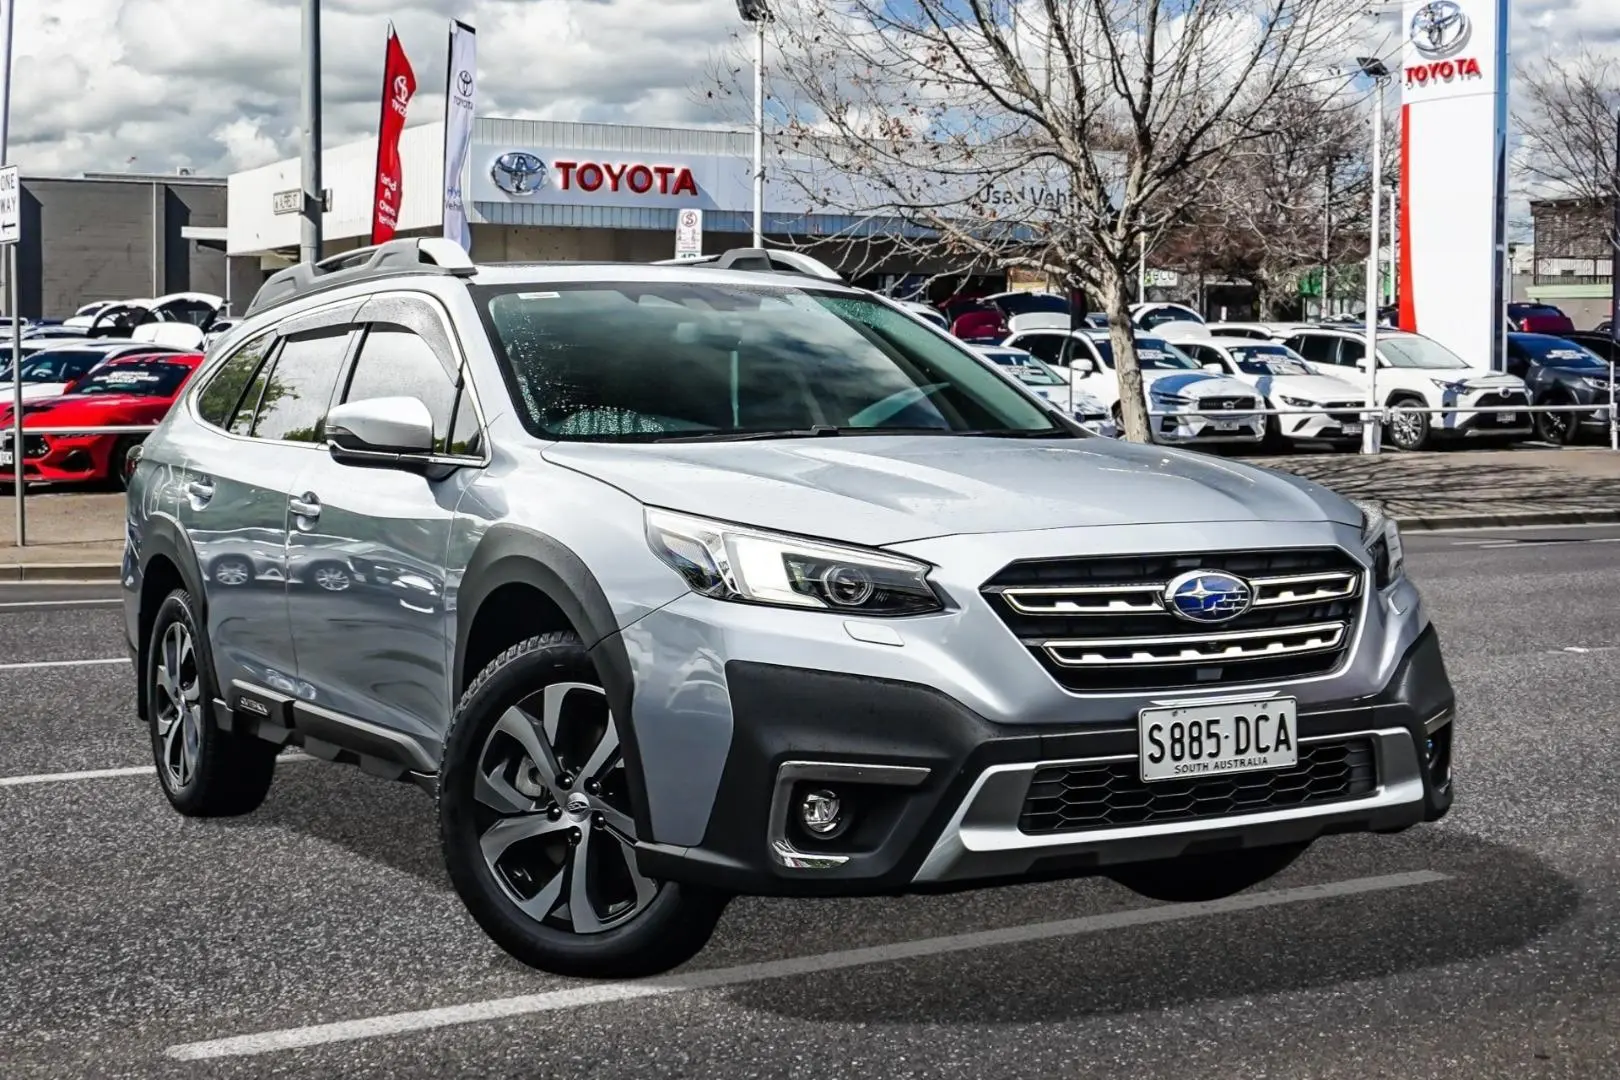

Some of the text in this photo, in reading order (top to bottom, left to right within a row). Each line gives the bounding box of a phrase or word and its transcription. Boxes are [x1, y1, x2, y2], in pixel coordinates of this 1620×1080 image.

[1404, 58, 1480, 83] TOYOTA
[1, 173, 15, 191] ONE
[555, 161, 698, 196] TOYOTA
[0, 196, 16, 215] WAY
[1174, 756, 1268, 774] SOUTH AUSTRALIA
